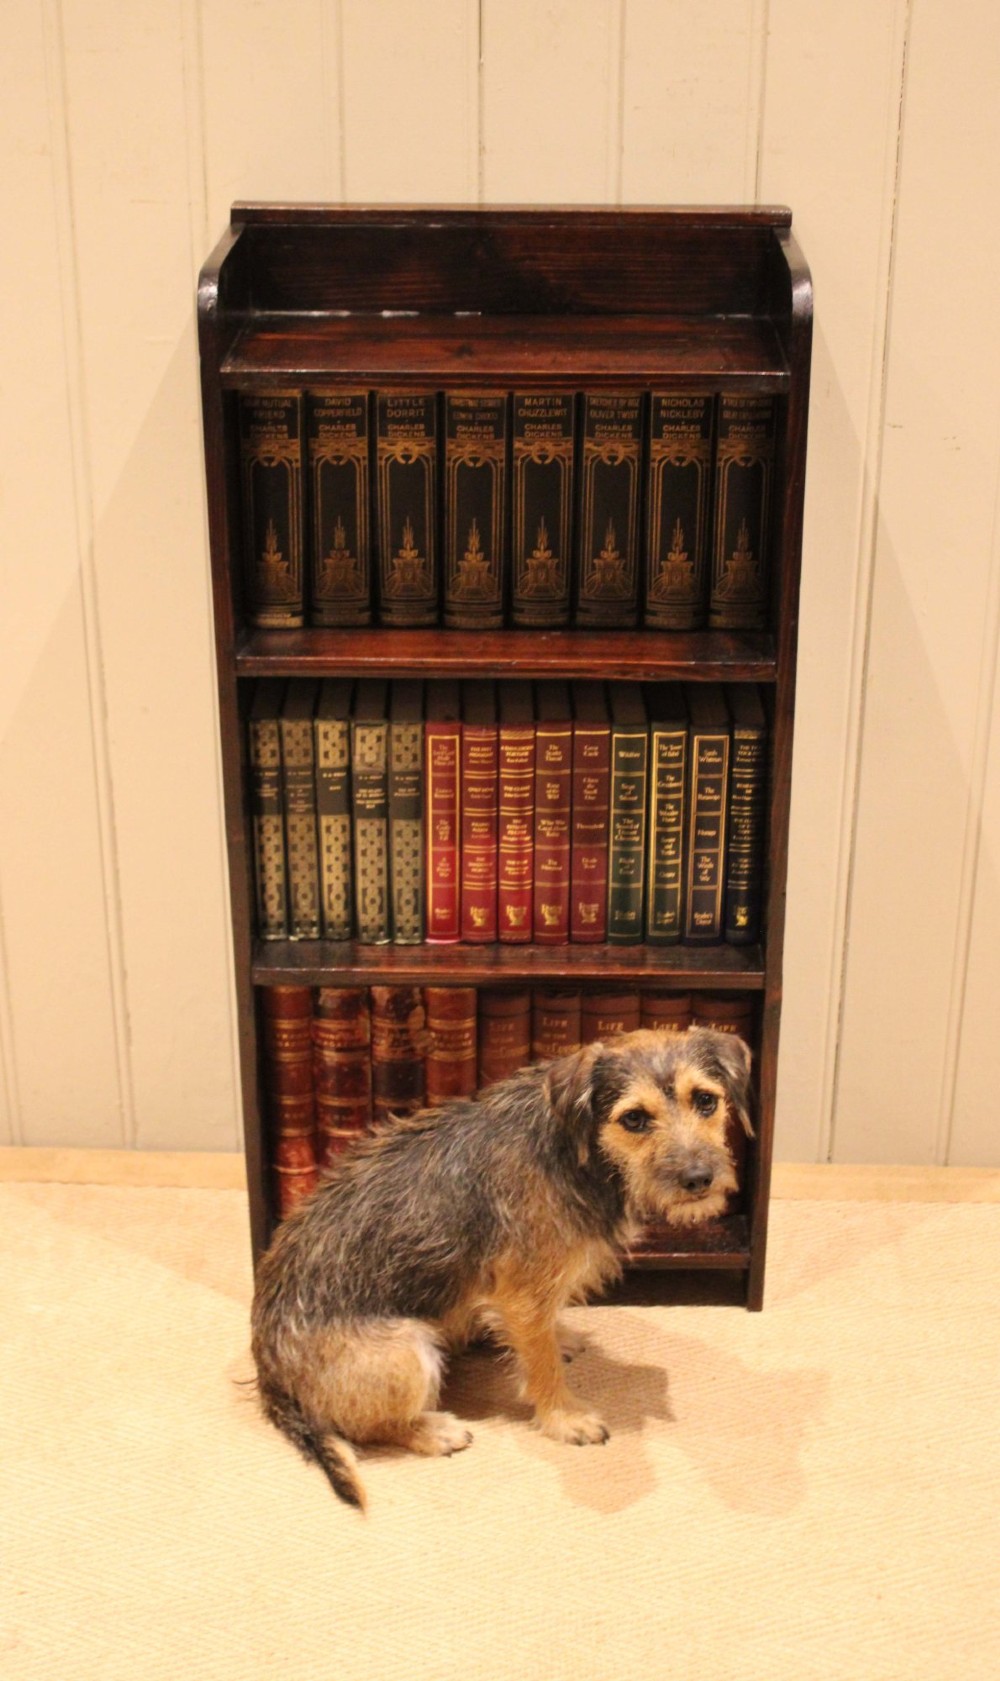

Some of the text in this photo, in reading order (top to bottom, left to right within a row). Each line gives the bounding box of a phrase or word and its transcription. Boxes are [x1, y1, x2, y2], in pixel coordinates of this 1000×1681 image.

[325, 398, 351, 406] DAVID
[387, 398, 425, 407] LITTLE
[524, 397, 562, 406] MARTIN
[661, 398, 704, 407] NICHOLAS
[314, 408, 362, 417] COPPERFIELD
[386, 407, 425, 418] DORRIT
[518, 407, 567, 417] CHUZZLEWIT
[590, 409, 639, 419] OLIVER TWIST
[660, 409, 705, 418] NICKLEBY
[250, 424, 288, 432] CHARLES
[319, 423, 356, 431] CHARLES
[456, 424, 494, 432] CHARLES
[662, 424, 701, 432] CHARLES
[728, 424, 767, 432] CHARLES
[250, 432, 289, 440] DICKENS
[319, 431, 357, 439] DICKENS
[388, 430, 426, 438] DICKENS
[456, 432, 495, 440] DICKENS
[524, 430, 563, 438] DICKENS
[594, 431, 633, 439] DICKENS
[662, 432, 701, 440] DICKENS
[543, 1016, 568, 1029] LIFE
[597, 1020, 624, 1032] LIFE
[652, 1020, 680, 1031] LIFE
